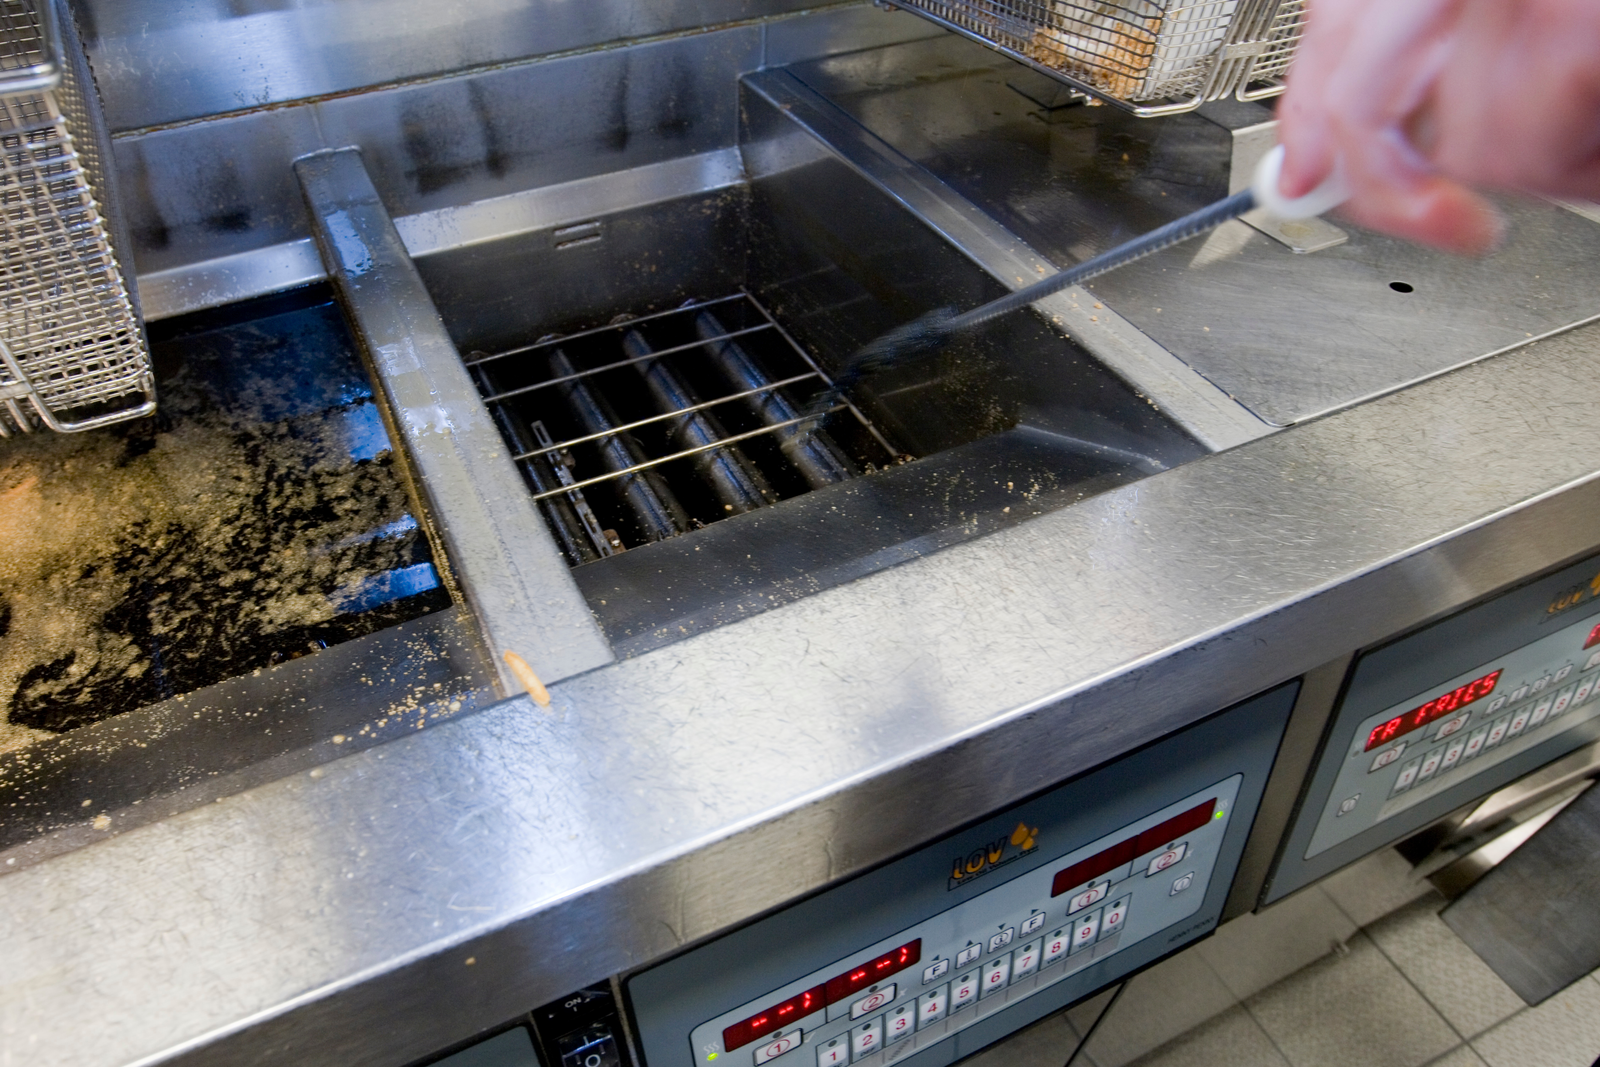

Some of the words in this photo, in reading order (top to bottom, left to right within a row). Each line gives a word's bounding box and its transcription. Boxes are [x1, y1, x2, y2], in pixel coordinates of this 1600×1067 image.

[1369, 717, 1401, 741] FR
[1414, 671, 1499, 725] FRIES
[953, 836, 1008, 880] LOV
[1029, 918, 1038, 929] F
[931, 965, 942, 976] F
[829, 1051, 837, 1061] 1
[862, 1034, 873, 1047] 2
[896, 1018, 906, 1030] 3
[927, 1002, 938, 1013] 4
[959, 986, 970, 999] 5
[991, 971, 1001, 983] 6
[1022, 955, 1032, 968] 7
[1051, 941, 1061, 954] 8
[1081, 927, 1091, 939] 9
[1109, 913, 1119, 924] 0
[564, 997, 582, 1008] ON
